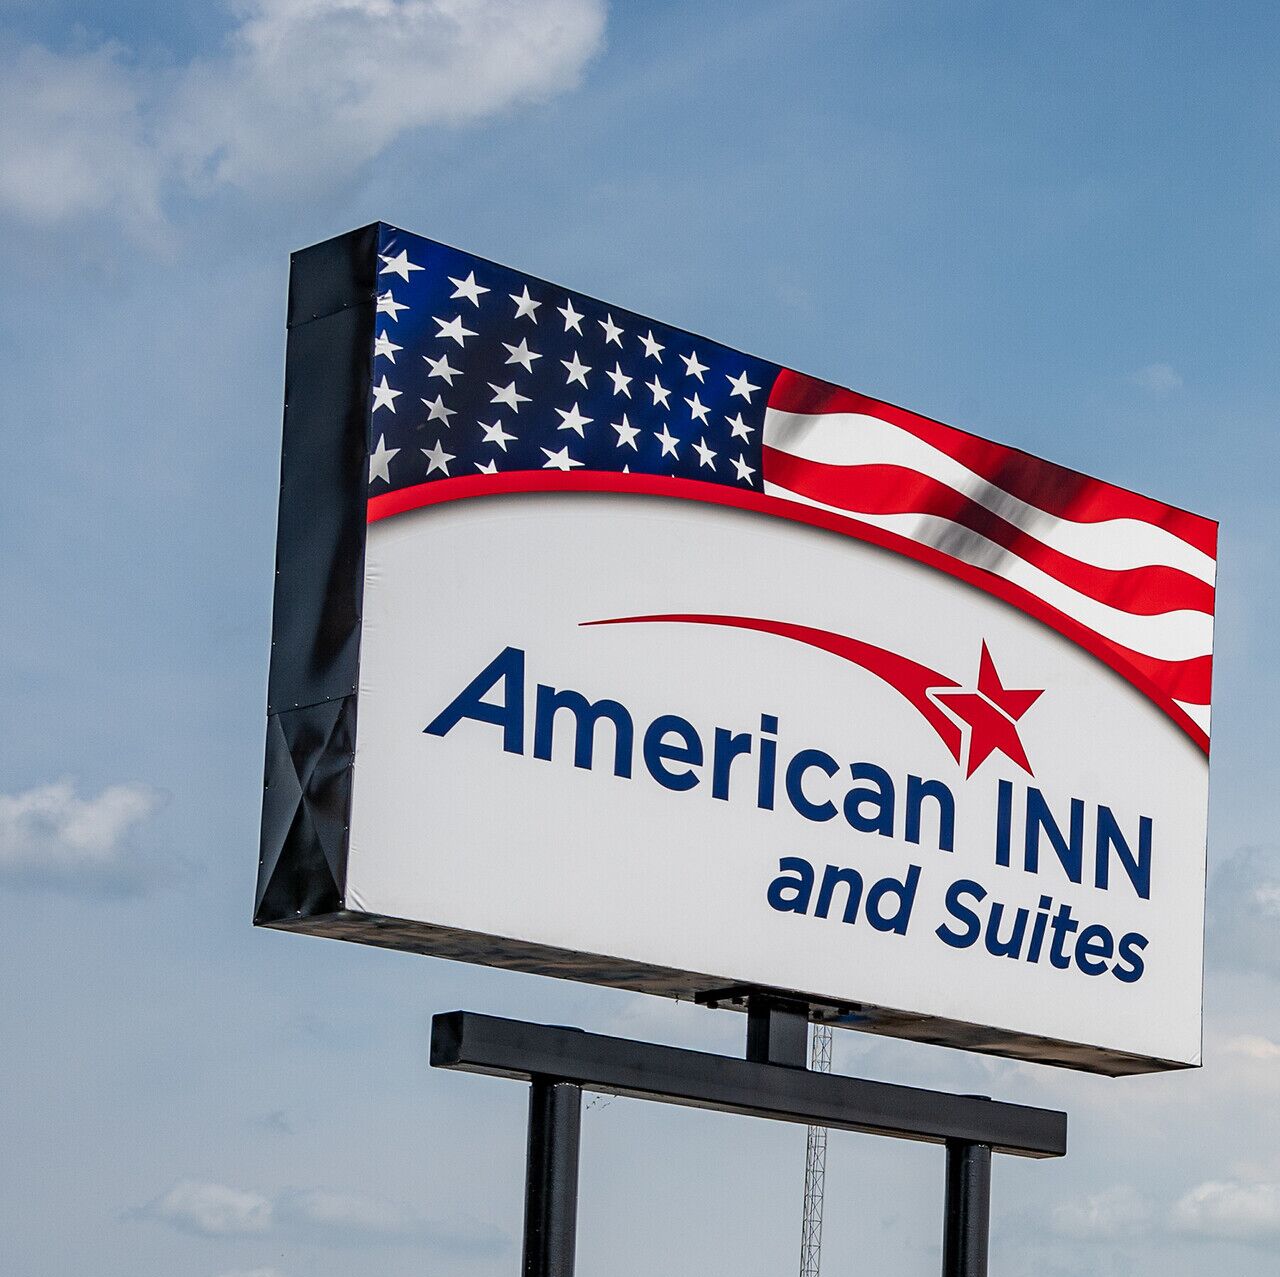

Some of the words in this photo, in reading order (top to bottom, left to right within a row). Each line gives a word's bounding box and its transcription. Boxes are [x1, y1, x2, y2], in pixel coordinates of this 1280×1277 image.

[423, 645, 955, 852] American
[995, 779, 1153, 900] INN
[766, 855, 921, 936] and
[935, 879, 1148, 983] Suites
